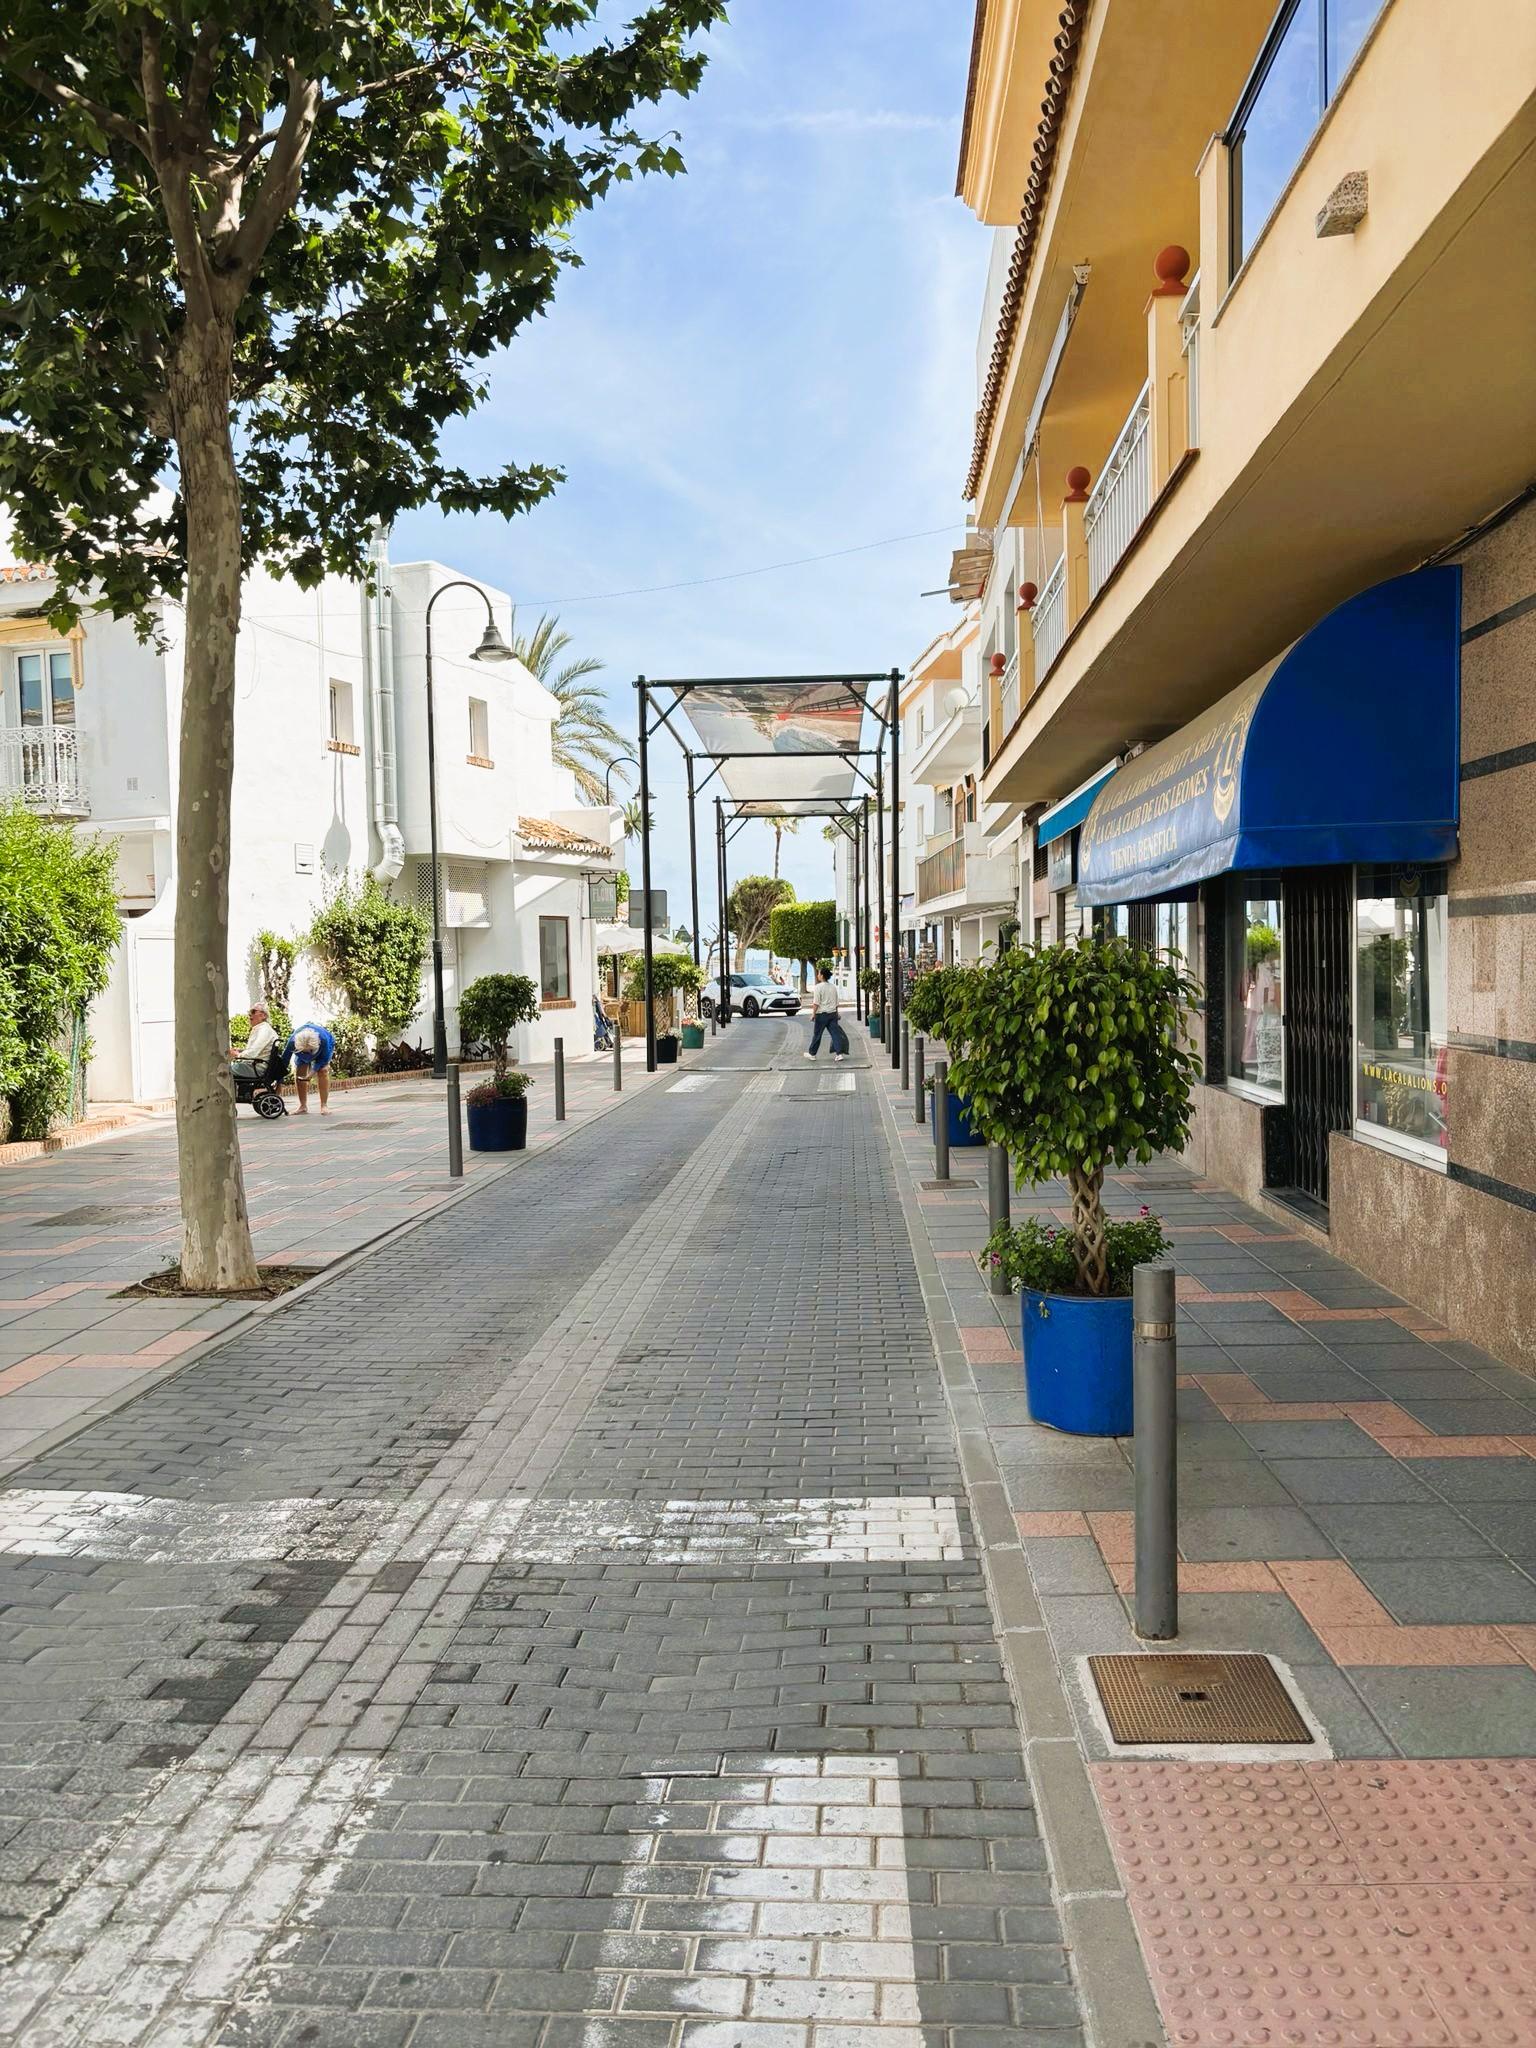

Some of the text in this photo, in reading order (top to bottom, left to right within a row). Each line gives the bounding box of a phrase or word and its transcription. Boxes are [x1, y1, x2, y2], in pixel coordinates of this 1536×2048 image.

[1150, 747, 1191, 788] CHARITY
[1190, 721, 1226, 763] SHOP
[1096, 766, 1210, 846] LA CALA CLUB DE LOS LEONES
[1110, 844, 1136, 870] TIENDA
